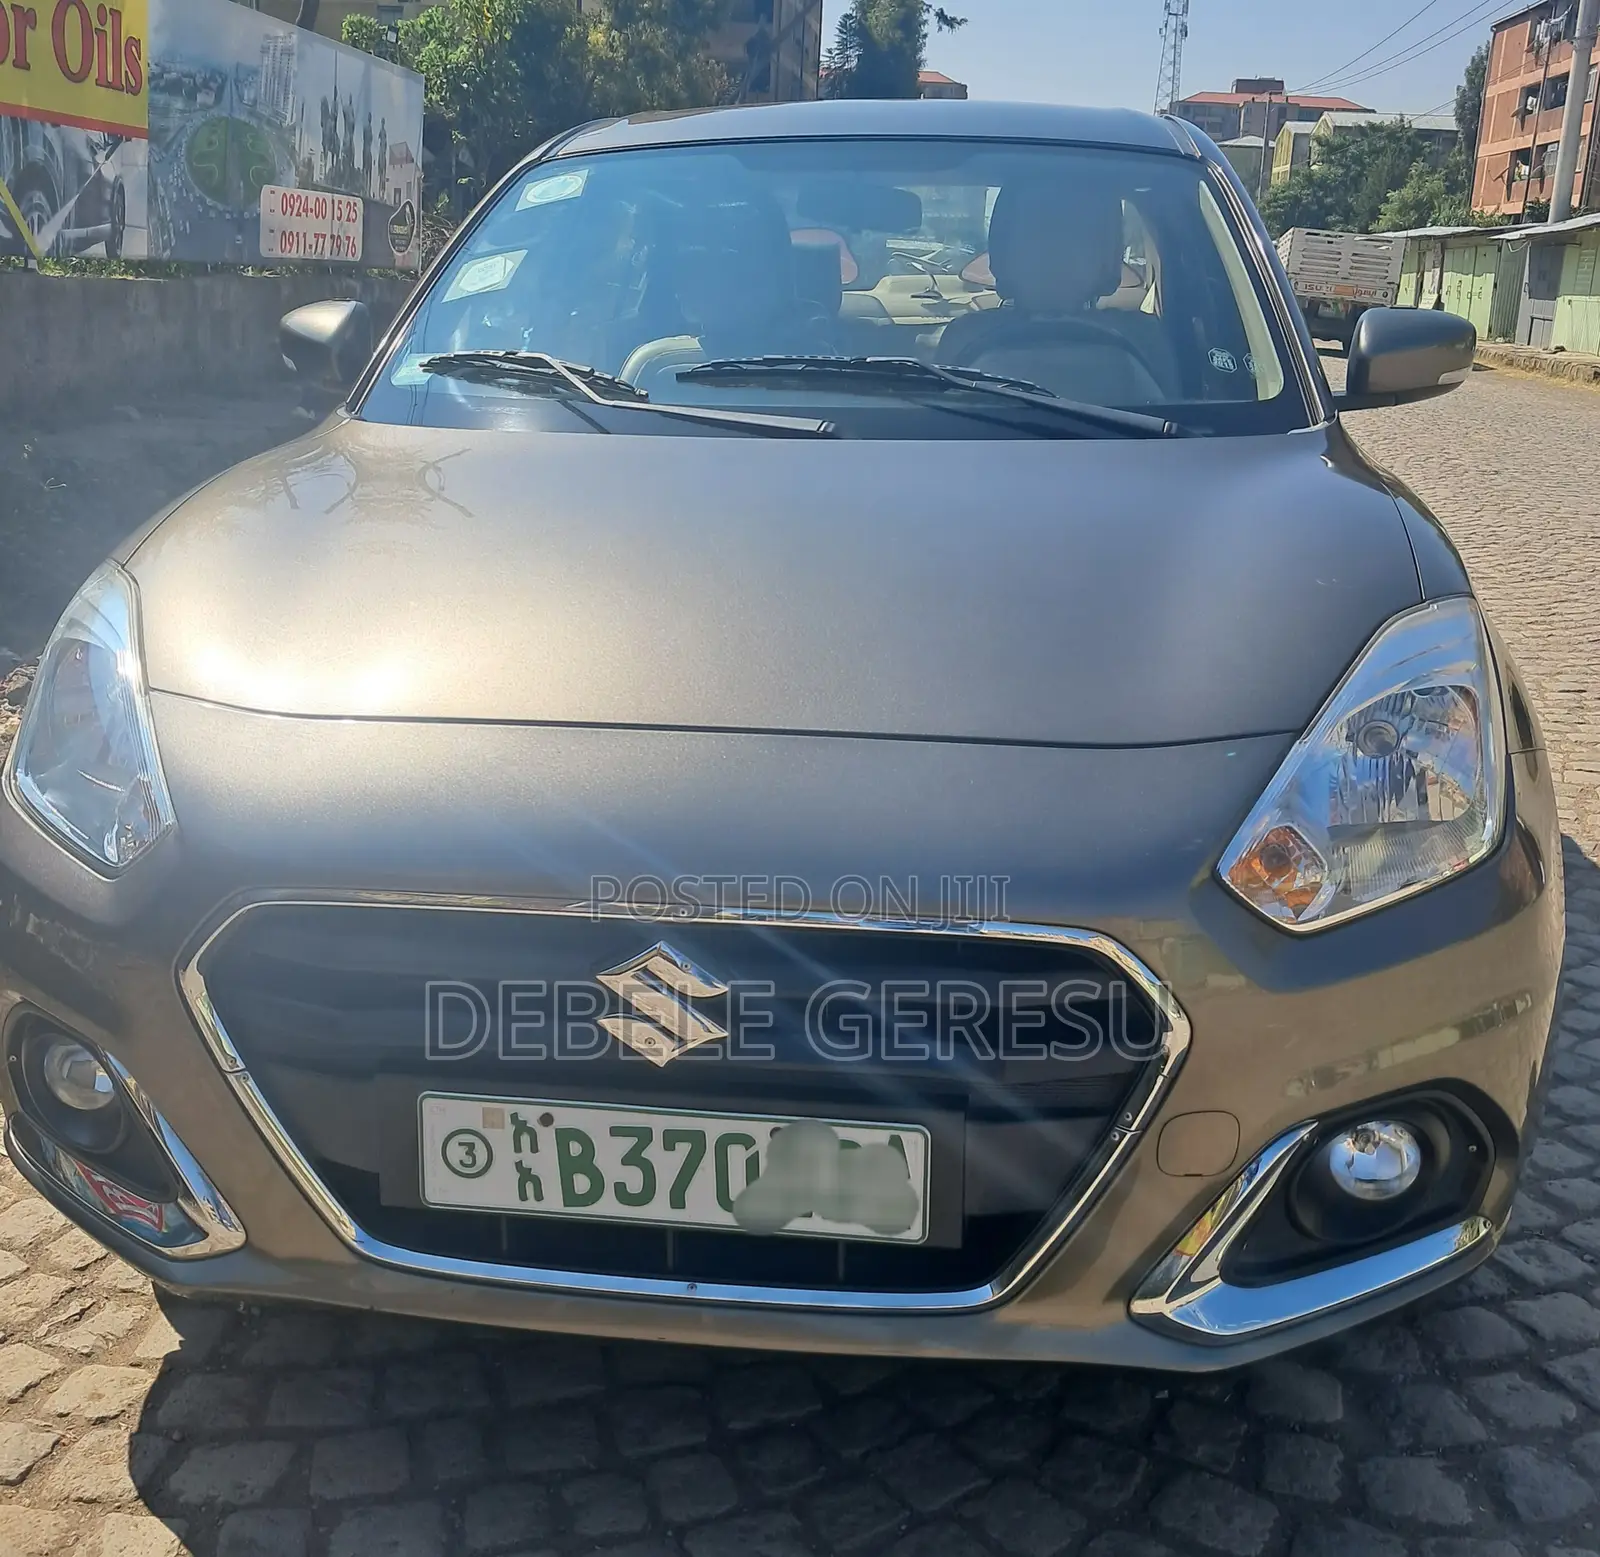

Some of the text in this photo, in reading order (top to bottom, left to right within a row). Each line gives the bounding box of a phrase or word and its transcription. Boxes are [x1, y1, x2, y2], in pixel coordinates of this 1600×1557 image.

[52, 0, 143, 96] Oils
[331, 200, 343, 222] 15
[346, 201, 358, 224] 25
[330, 233, 343, 256] 79
[345, 234, 357, 258] 76
